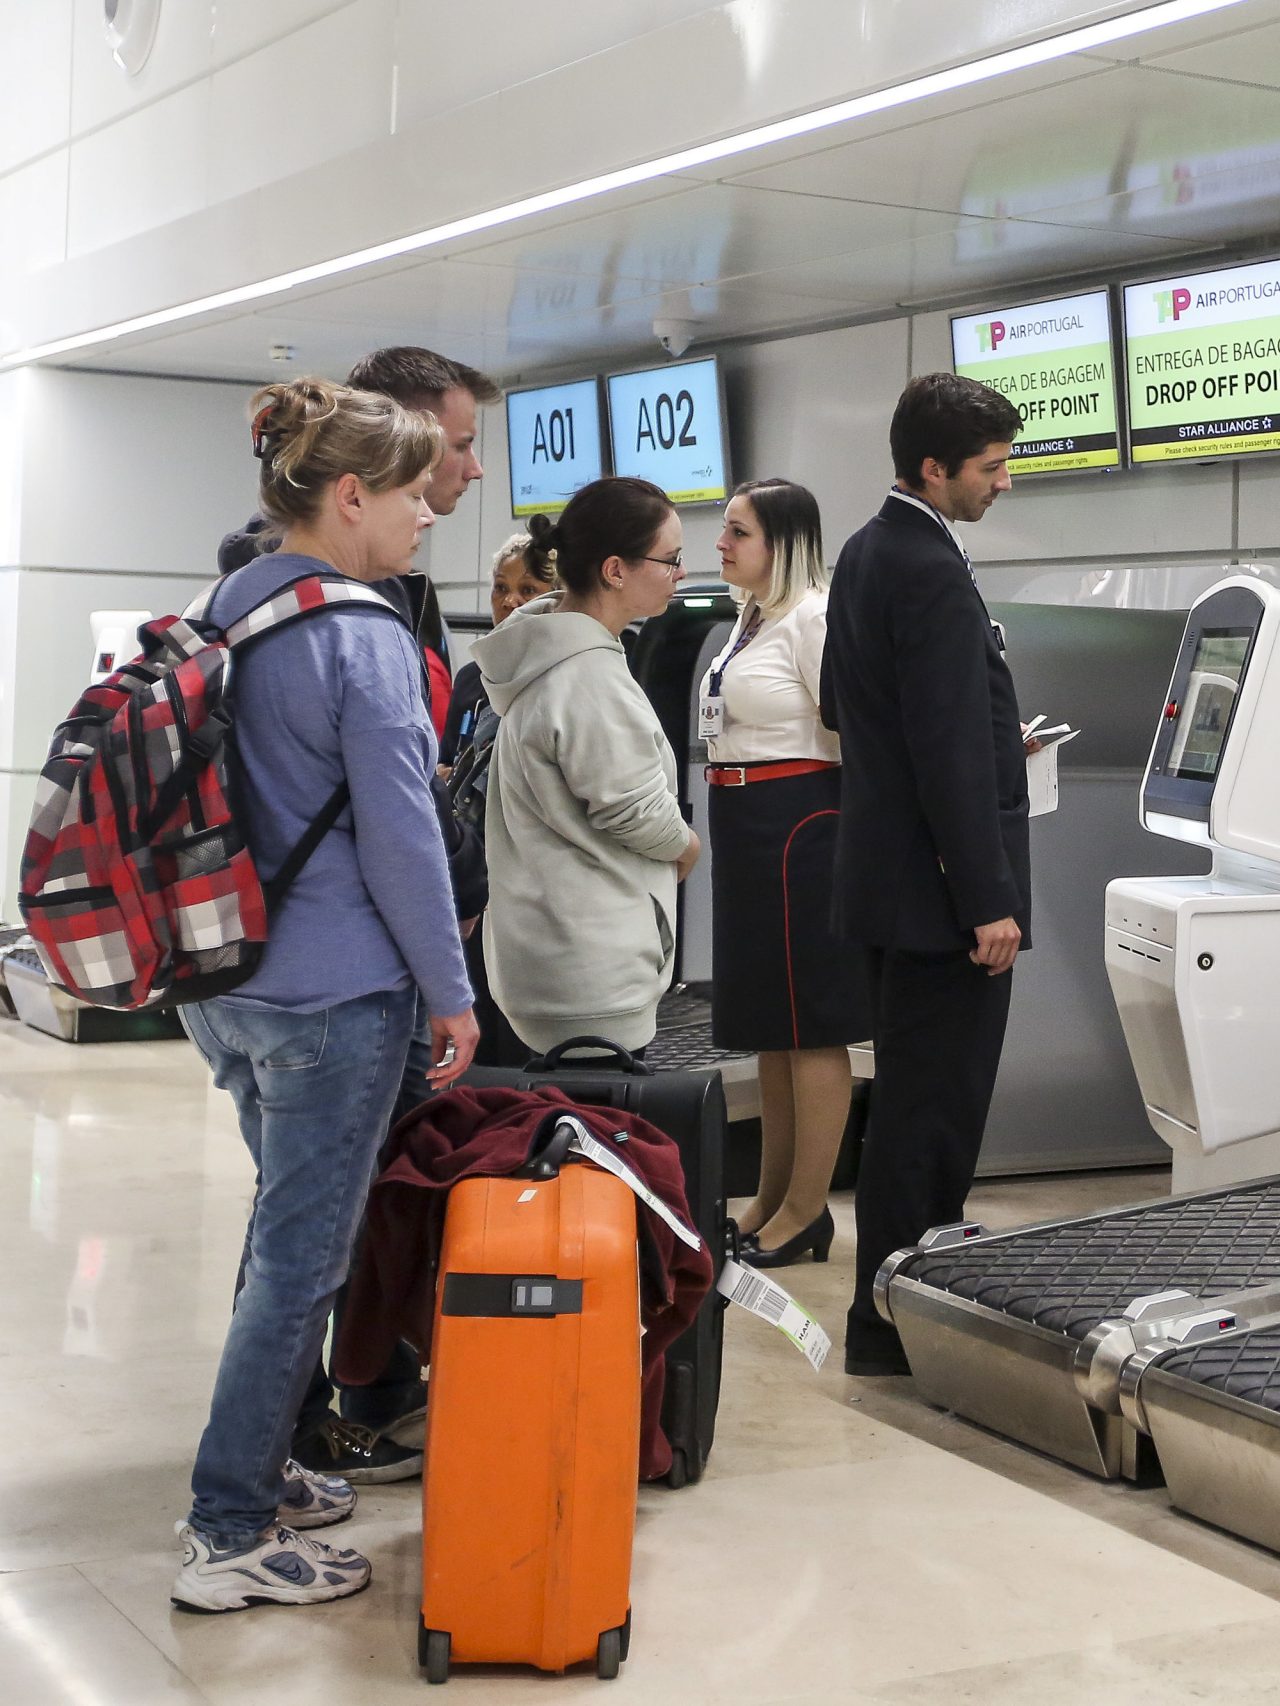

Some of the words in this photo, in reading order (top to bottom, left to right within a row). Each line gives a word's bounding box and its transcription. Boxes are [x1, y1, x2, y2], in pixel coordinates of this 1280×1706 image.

[1136, 348, 1204, 374] ENTREGA
[1208, 344, 1229, 364] DE
[1020, 373, 1037, 391] DE
[1040, 363, 1105, 388] BAGAGEM
[1146, 380, 1197, 406] DROP
[1202, 375, 1238, 399] OFF
[637, 389, 697, 453] A02
[1018, 400, 1046, 422] OFF
[1050, 393, 1099, 418] POINT
[532, 407, 575, 464] A01
[1179, 425, 1206, 437] STAR
[1207, 419, 1259, 434] ALLIANCE
[1010, 445, 1020, 456] AR
[1022, 440, 1064, 454] ALLIANCE
[1165, 447, 1181, 455] Please
[1182, 445, 1197, 453] check
[1198, 443, 1218, 453] security
[1219, 442, 1233, 450] rules
[1234, 440, 1243, 448] and
[1245, 439, 1272, 449] passenger
